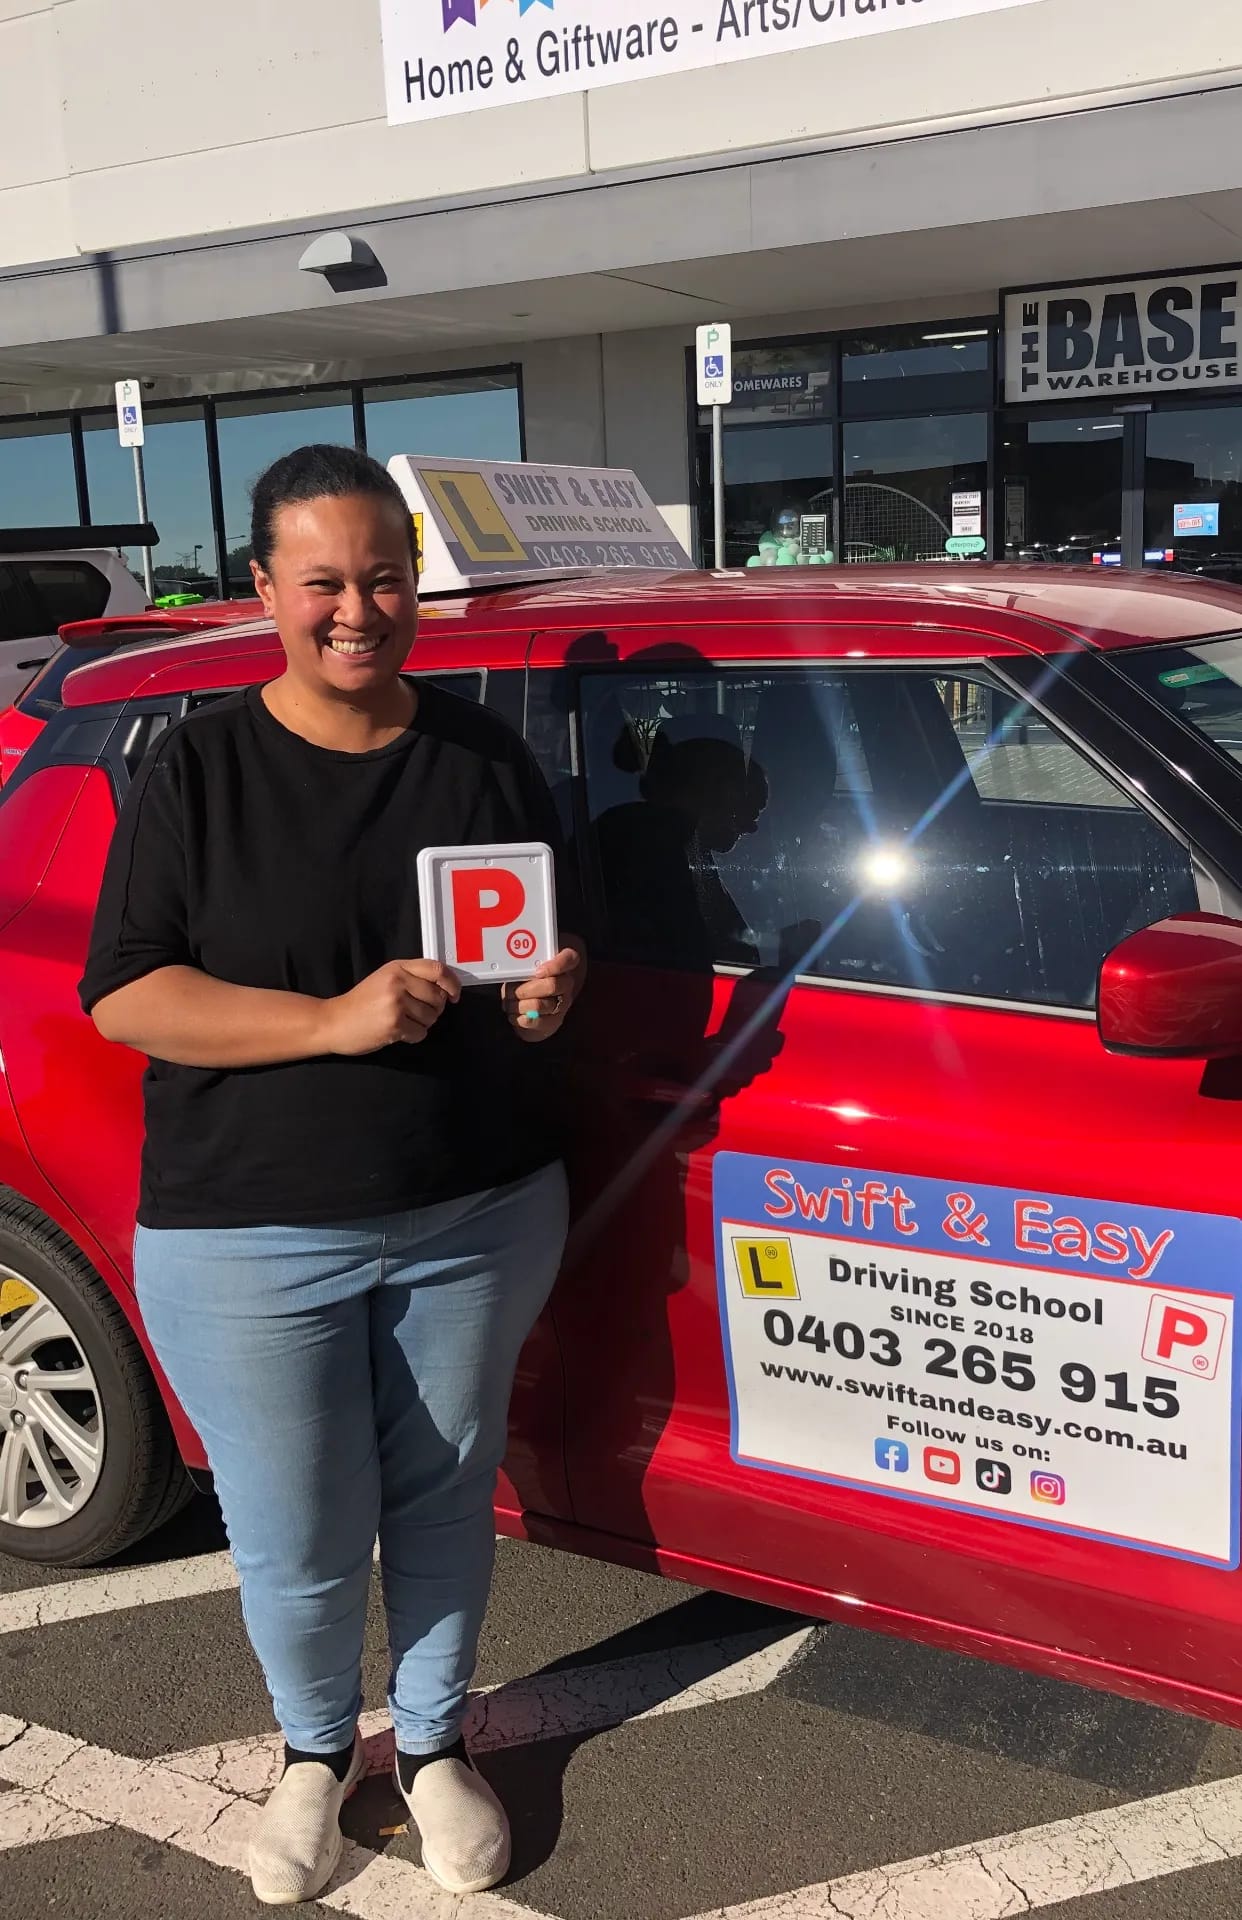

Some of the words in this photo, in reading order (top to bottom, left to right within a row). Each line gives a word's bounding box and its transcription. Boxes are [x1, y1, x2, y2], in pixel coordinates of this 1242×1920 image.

[404, 57, 494, 103] Home
[504, 37, 526, 84] &
[536, 16, 679, 77] Giftware
[691, 23, 704, 33] -
[707, 330, 720, 350] P
[1021, 302, 1039, 393] THE
[1046, 281, 1237, 373] BASE
[704, 380, 723, 389] ONLY
[734, 376, 802, 393] OMEWARES
[1047, 362, 1238, 391] WAREHOUSE
[494, 472, 569, 506] SWIFT
[567, 476, 595, 507] &
[588, 478, 644, 509] EASY
[439, 480, 515, 553] L
[525, 515, 594, 533] DRIVING
[592, 516, 653, 533] SCHOOL
[533, 545, 592, 568] 0403
[596, 545, 637, 566] 265
[639, 545, 678, 566] 915
[451, 868, 526, 963] P
[513, 938, 530, 950] 90
[764, 1168, 919, 1235] Swift
[942, 1191, 990, 1247] &
[1014, 1198, 1175, 1280] Easy
[748, 1246, 783, 1289] L
[829, 1256, 957, 1308] Driving
[969, 1280, 1103, 1325] School
[890, 1305, 965, 1332] SINCE
[974, 1319, 1034, 1344] 2018
[1157, 1305, 1208, 1359] P
[763, 1308, 903, 1368] 0403
[924, 1337, 1036, 1392] 265
[1059, 1361, 1180, 1419] 915
[760, 1361, 1188, 1461] www.swiftandeasy.com.au
[887, 1414, 967, 1444] Follow
[975, 1435, 1004, 1452] us
[1012, 1443, 1051, 1462] on:
